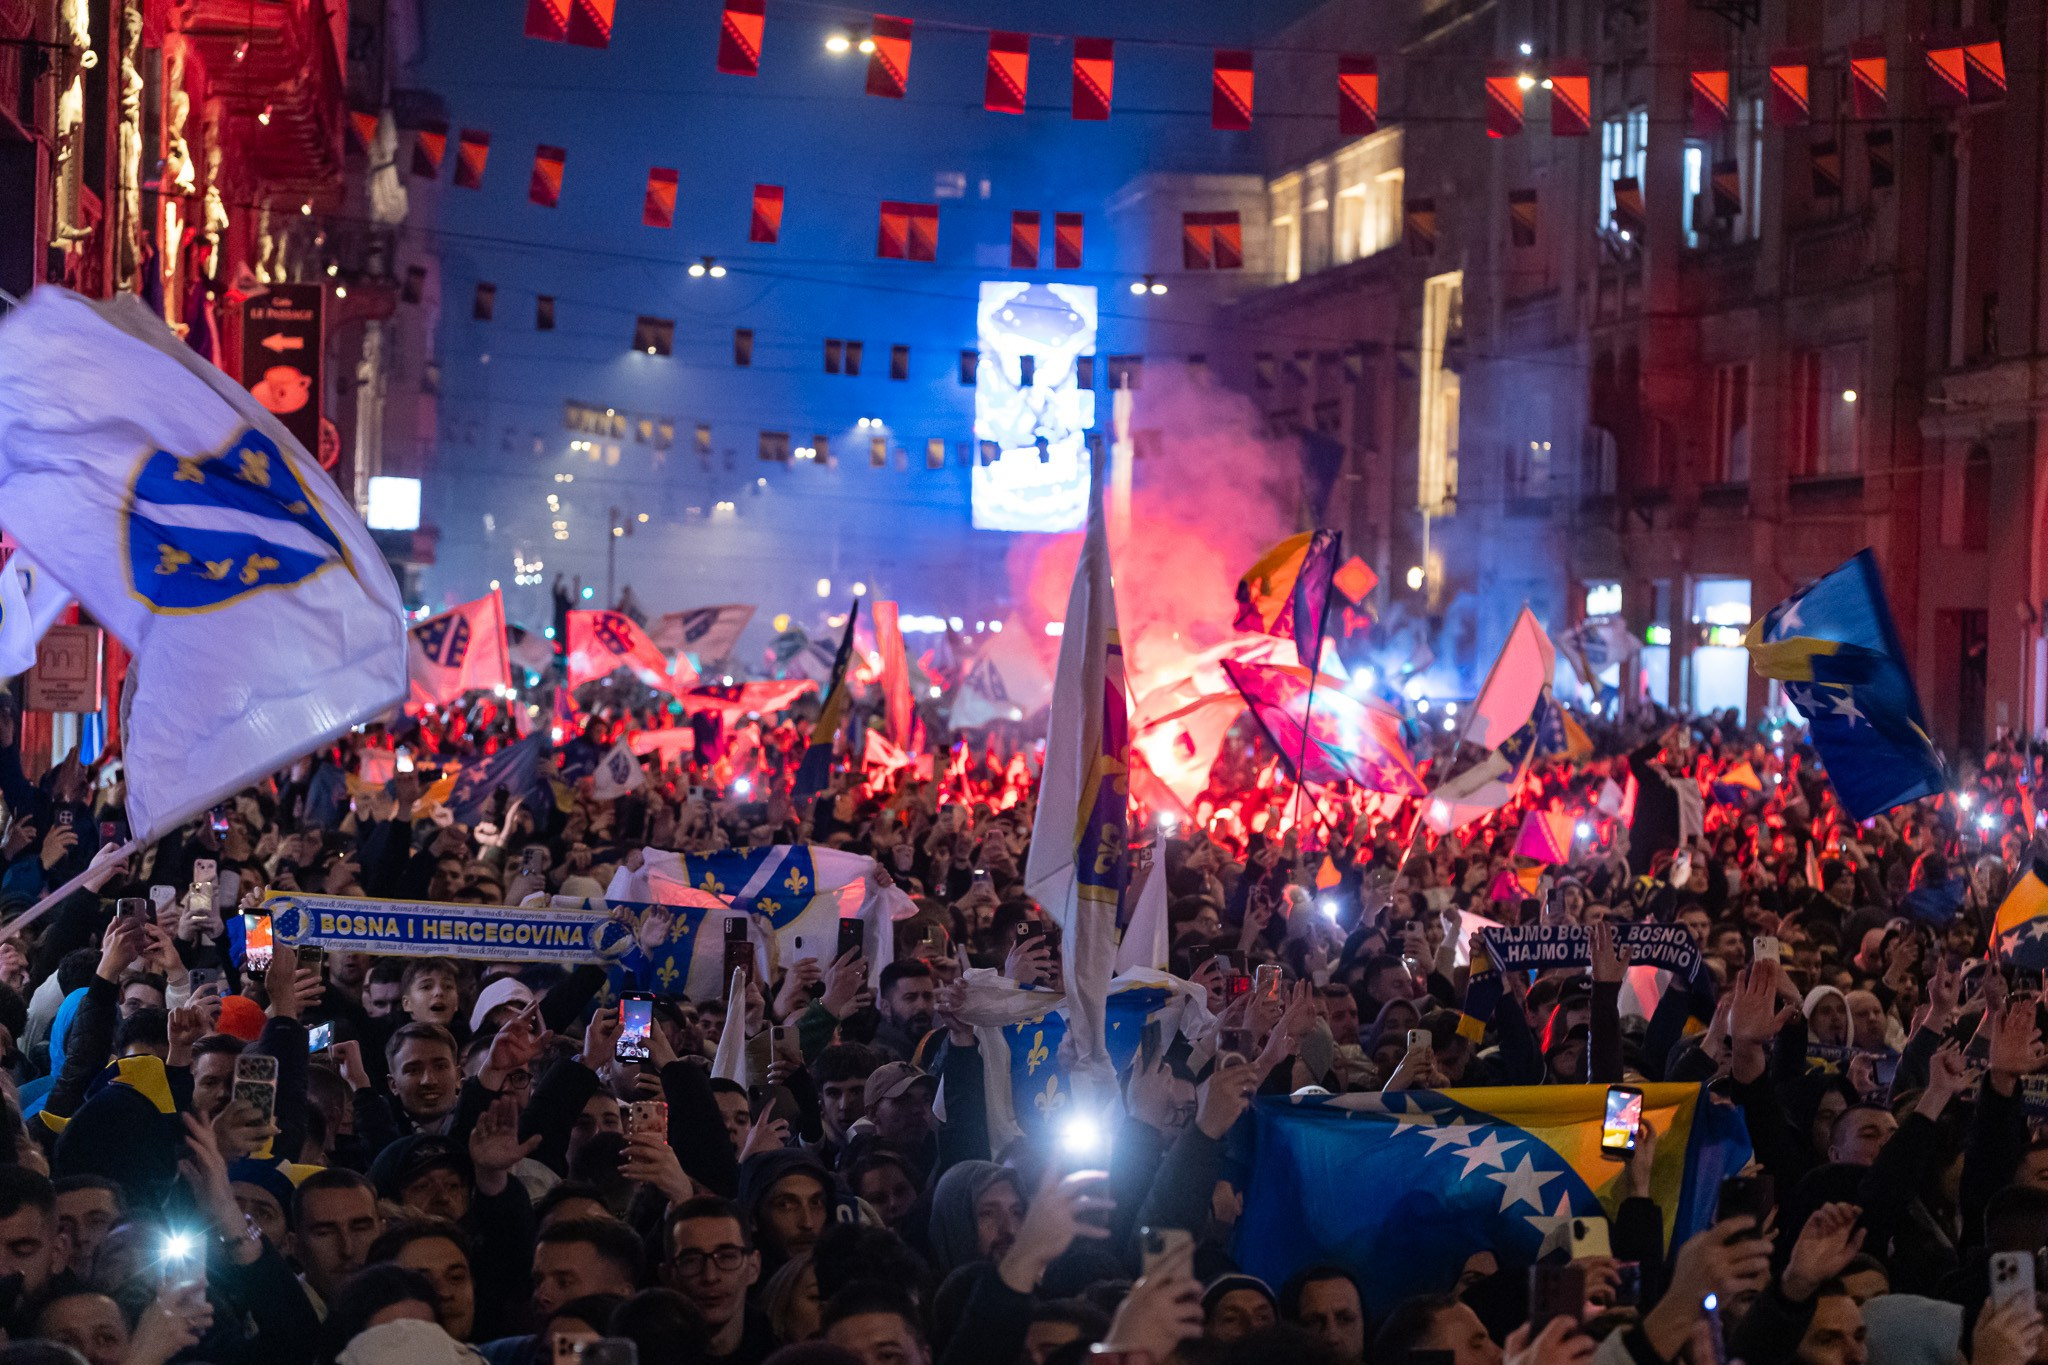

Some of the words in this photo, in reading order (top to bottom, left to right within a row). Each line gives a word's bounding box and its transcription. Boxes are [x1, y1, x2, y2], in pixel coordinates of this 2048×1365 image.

[473, 909, 495, 917] Bosna
[320, 913, 401, 938] BOSNA
[408, 918, 414, 939] I
[422, 919, 584, 946] HERCEGOVINA
[1488, 925, 1553, 944] HAJMO
[1557, 924, 1622, 943] BOSO,
[1627, 926, 1696, 954] BOSNO...
[457, 946, 478, 954] Bosna
